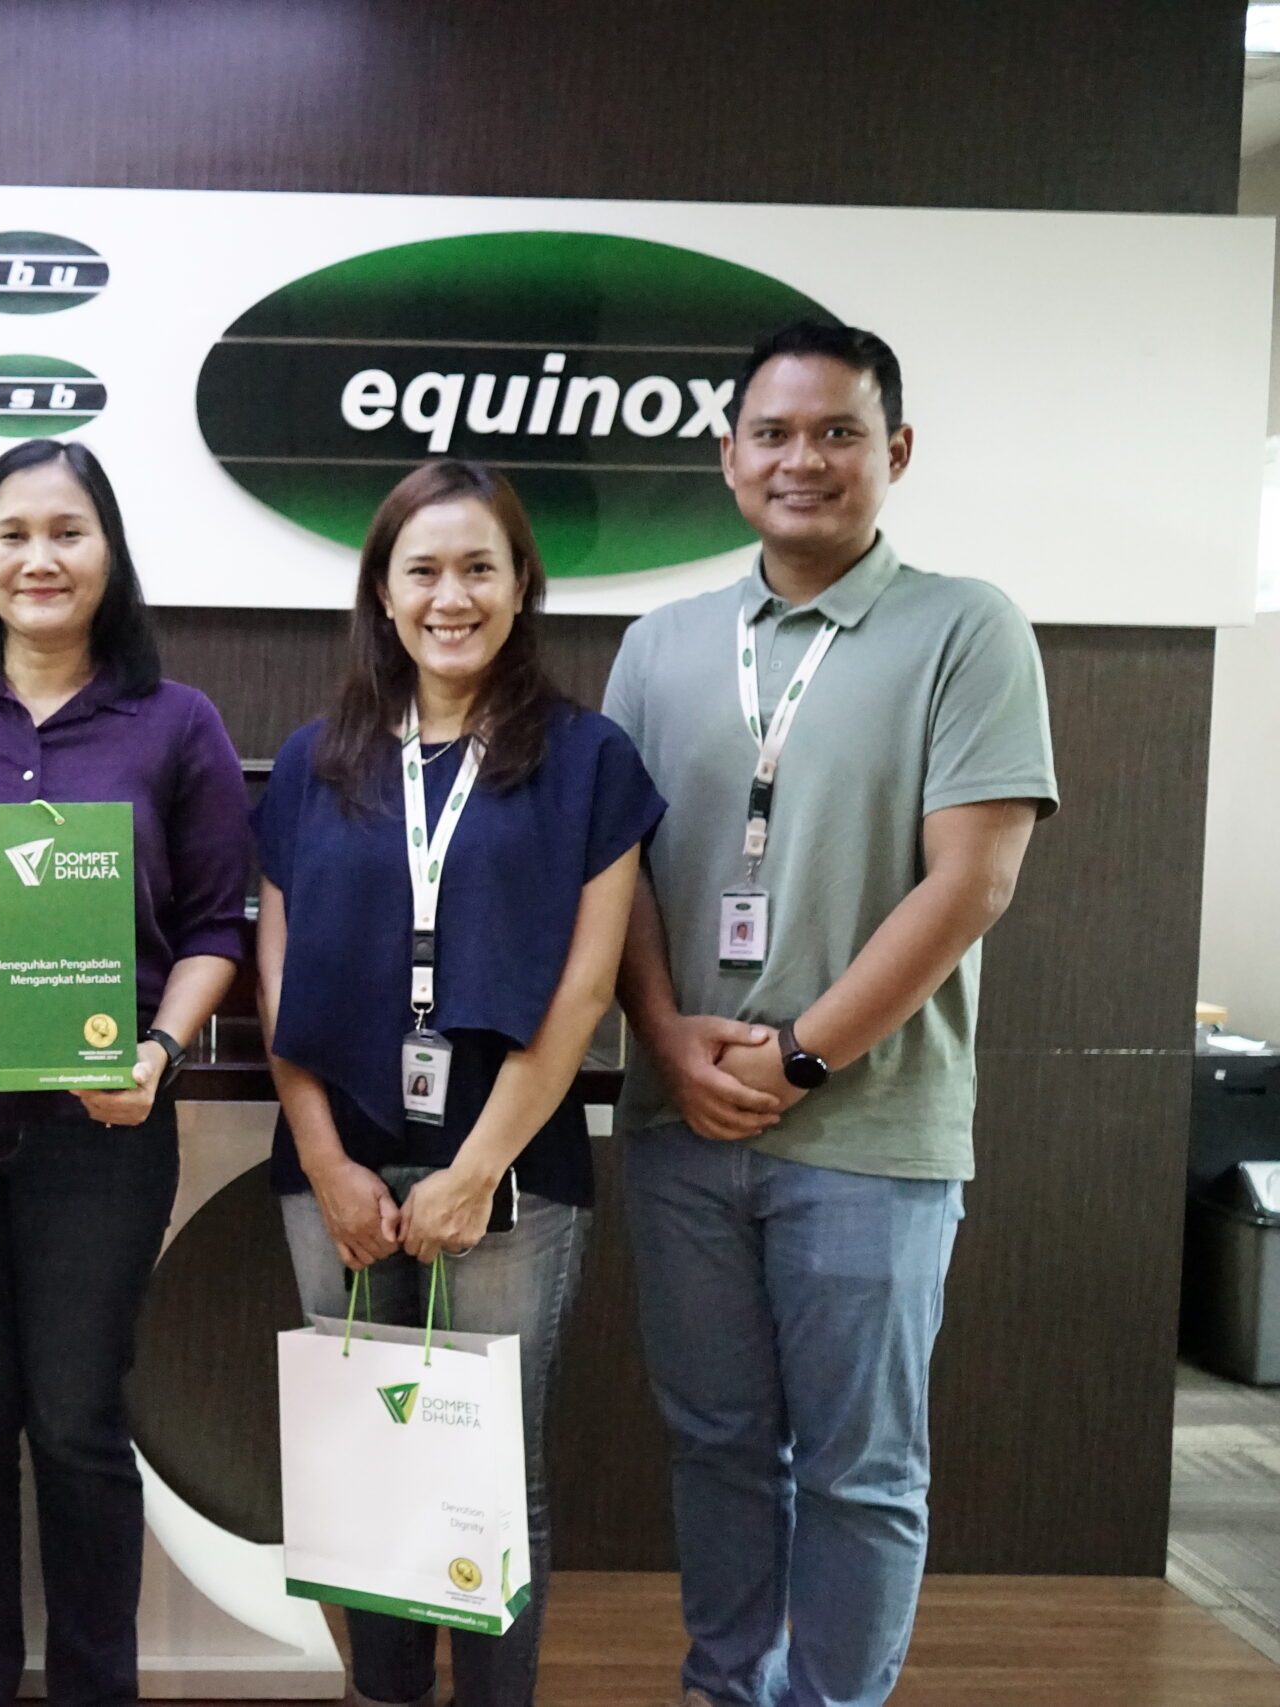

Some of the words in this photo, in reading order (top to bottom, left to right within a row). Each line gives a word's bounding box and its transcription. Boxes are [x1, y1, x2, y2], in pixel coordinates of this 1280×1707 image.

[341, 353, 736, 453] equinox
[55, 852, 119, 865] DOMPET
[55, 866, 120, 879] DHUAFA
[60, 959, 120, 971] Pengabdian
[10, 974, 74, 987] Mengangkat
[76, 974, 121, 984] Martabat
[422, 1397, 480, 1415] DOMPET
[422, 1410, 482, 1430] DHUAFA
